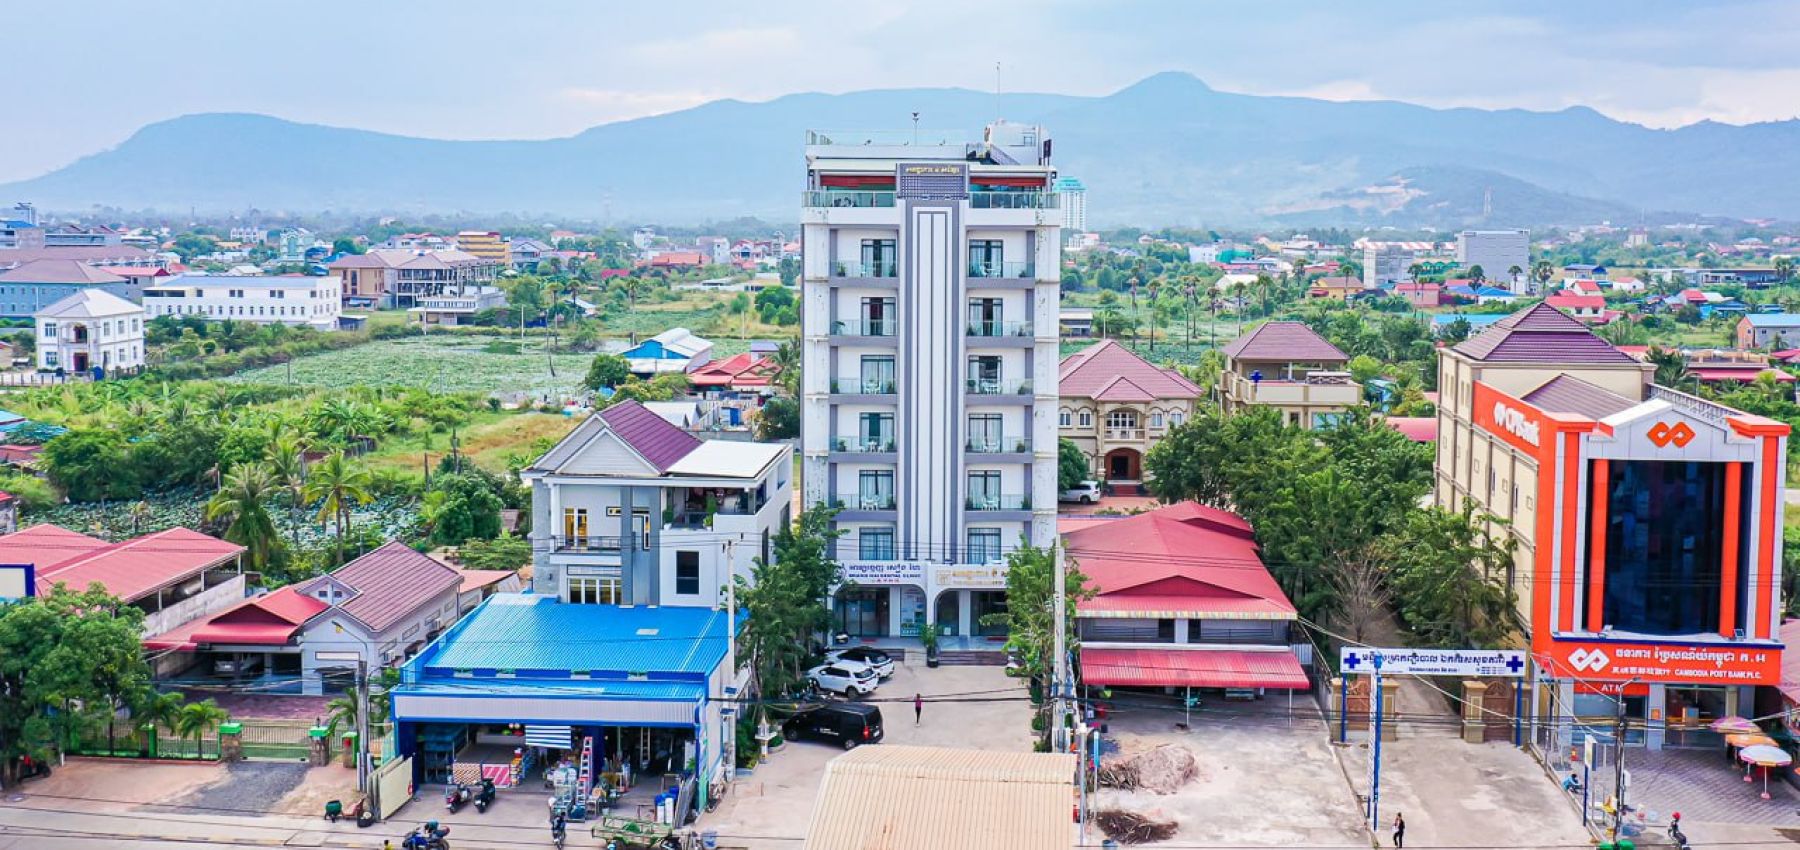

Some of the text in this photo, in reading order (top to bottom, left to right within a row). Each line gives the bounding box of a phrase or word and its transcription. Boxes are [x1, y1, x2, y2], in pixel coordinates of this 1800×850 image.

[1674, 668, 1708, 676] CAMBODIA
[1709, 670, 1727, 678] POST
[1601, 684, 1623, 693] ATM
